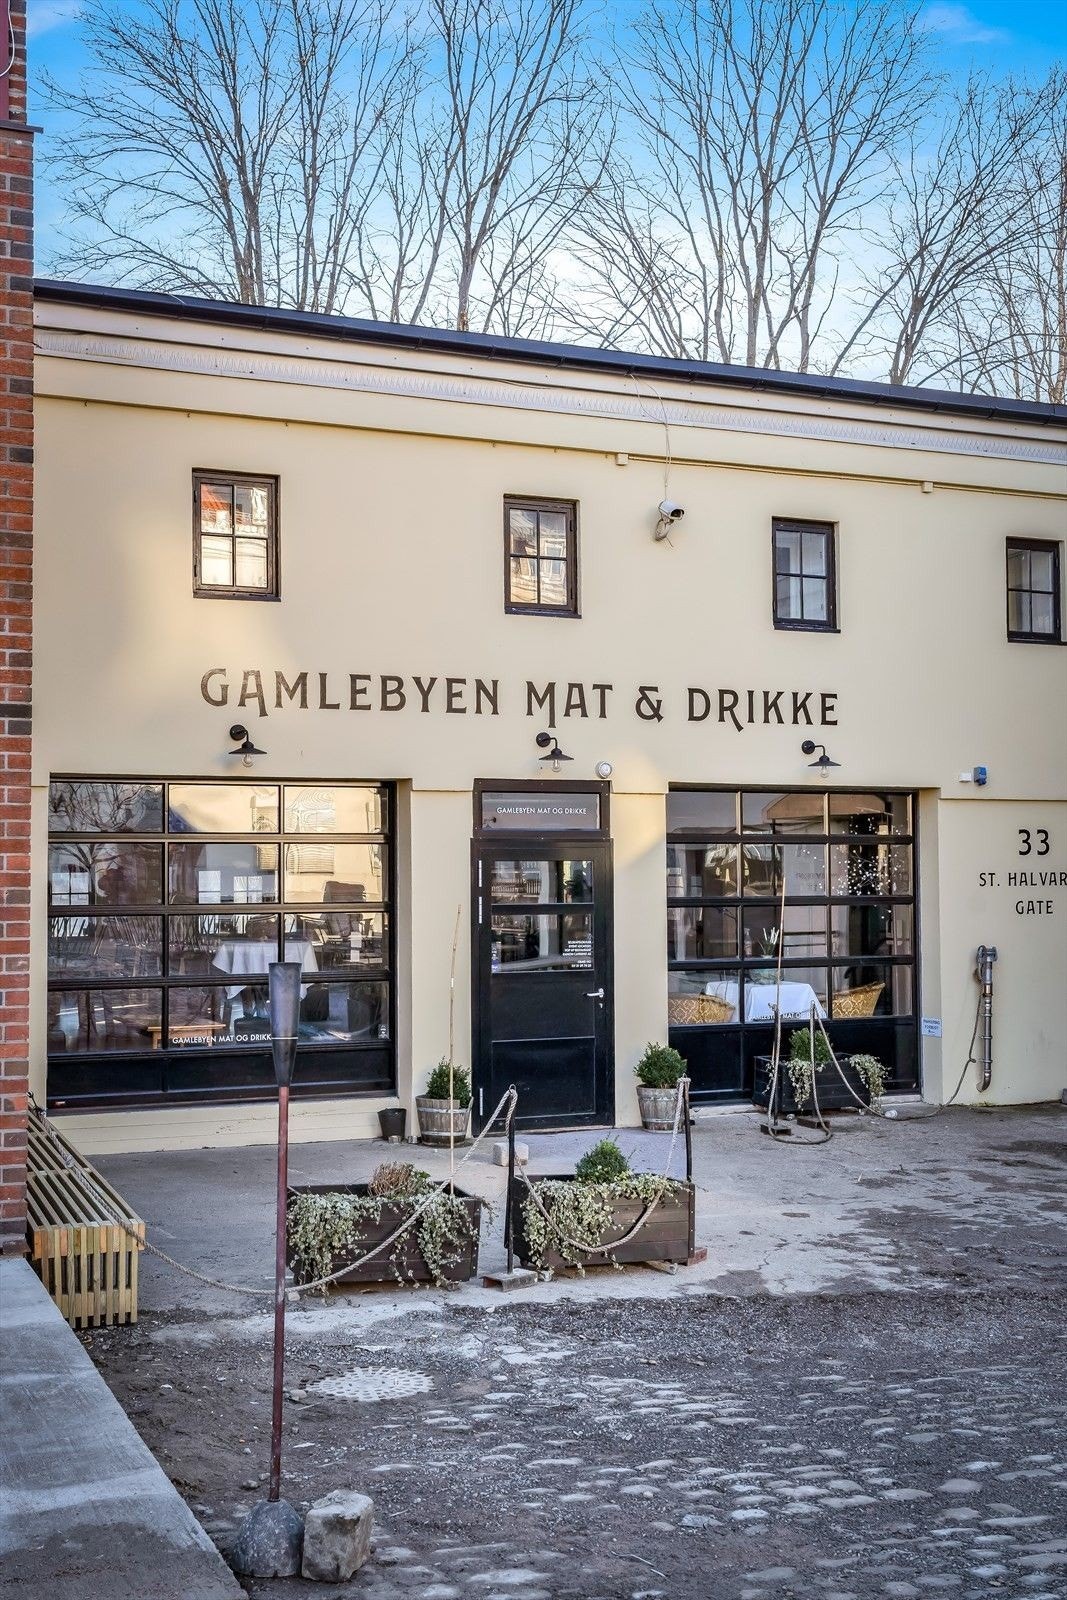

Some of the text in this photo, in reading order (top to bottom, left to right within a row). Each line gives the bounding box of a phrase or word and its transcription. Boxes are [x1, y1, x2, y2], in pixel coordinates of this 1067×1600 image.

[200, 668, 839, 733] GAMLEBYEN MAT & DRIKKE
[496, 807, 536, 815] GAMLEBYEN
[537, 807, 551, 815] MAT
[552, 807, 564, 815] OG
[1018, 828, 1050, 856] 33
[979, 872, 1000, 887] ST.
[1015, 900, 1054, 915] GATE
[172, 1033, 272, 1044] GAMLEBYEN MAT OG DRIKK
